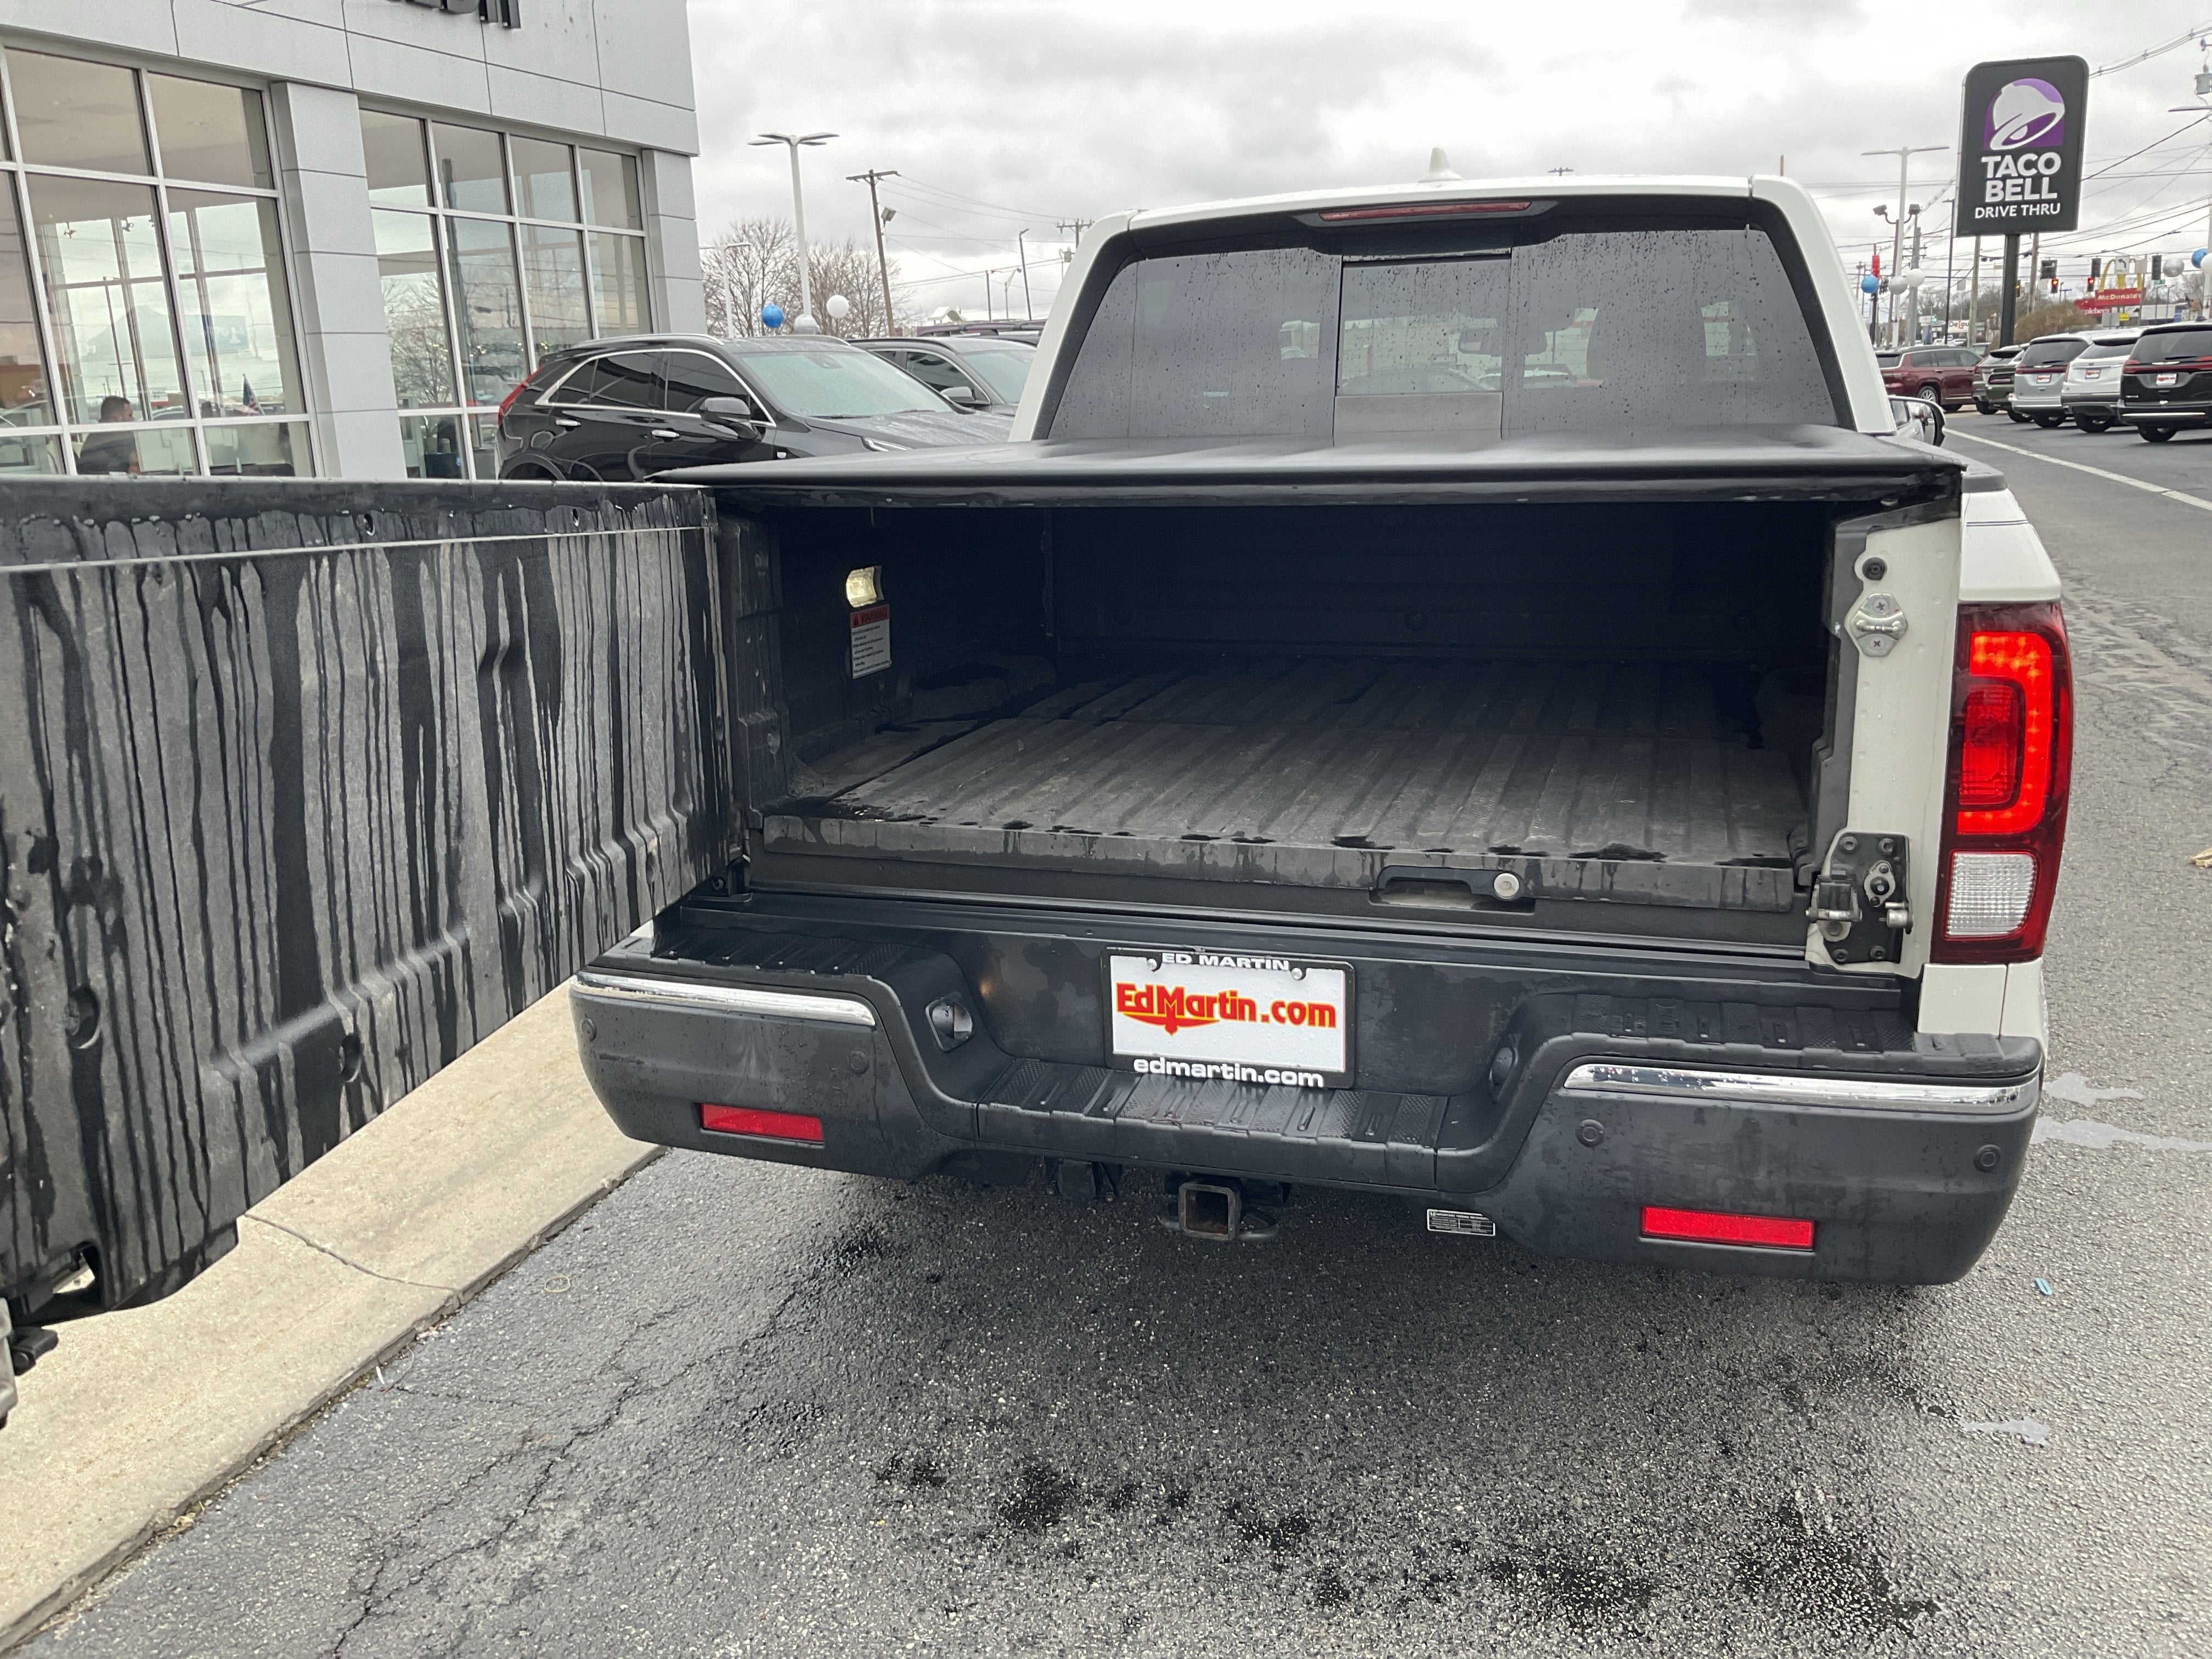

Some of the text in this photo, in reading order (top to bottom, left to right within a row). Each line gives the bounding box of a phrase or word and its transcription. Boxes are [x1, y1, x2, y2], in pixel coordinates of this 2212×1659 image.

[1981, 151, 2062, 178] TACO
[1985, 177, 2058, 202] BELL
[1975, 203, 2061, 219] DRIVE THRU
[1162, 953, 1289, 970] ED MARTIN
[1115, 982, 1337, 1029] EdMartin.com
[1133, 1057, 1324, 1088] edmartin.com
